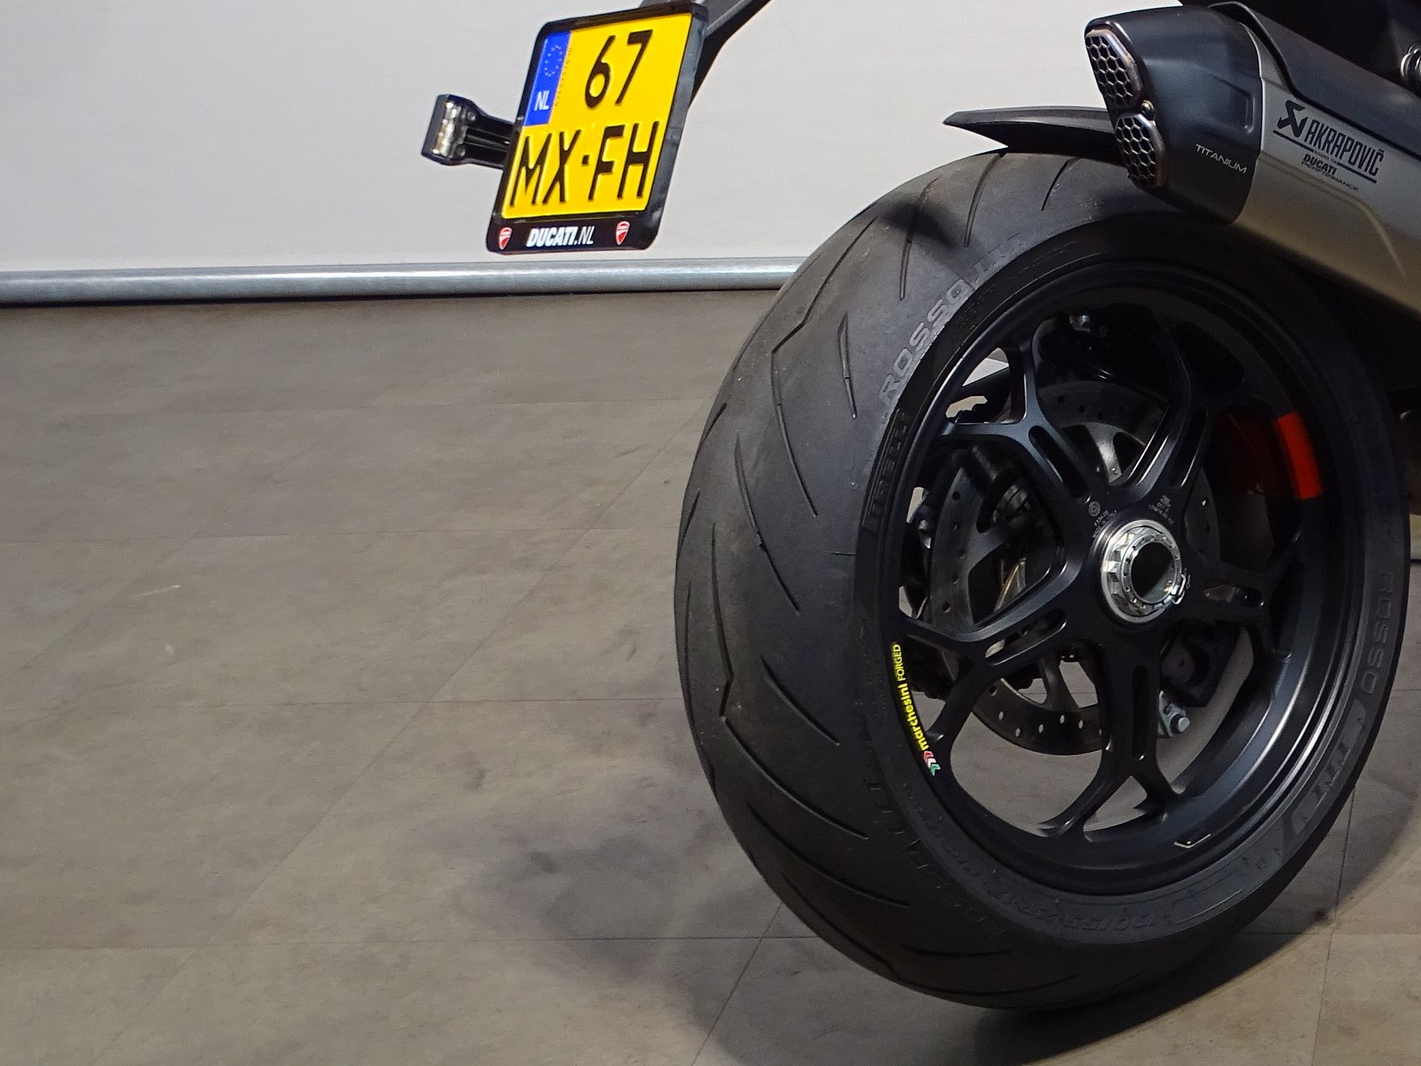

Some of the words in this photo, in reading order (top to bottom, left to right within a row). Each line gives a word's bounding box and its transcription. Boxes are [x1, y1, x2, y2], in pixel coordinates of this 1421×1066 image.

[584, 29, 653, 109] 67
[534, 90, 549, 111] NL
[1196, 144, 1247, 173] TITANIUM
[1303, 154, 1337, 175] DUCATI
[1304, 119, 1384, 176] AKRAPOVIČ
[526, 226, 595, 247] DUCATI.NL
[879, 278, 976, 409] ROSSO
[1359, 571, 1396, 697] ROSSO
[890, 642, 906, 681] FORGED
[897, 683, 929, 750] marchesini
